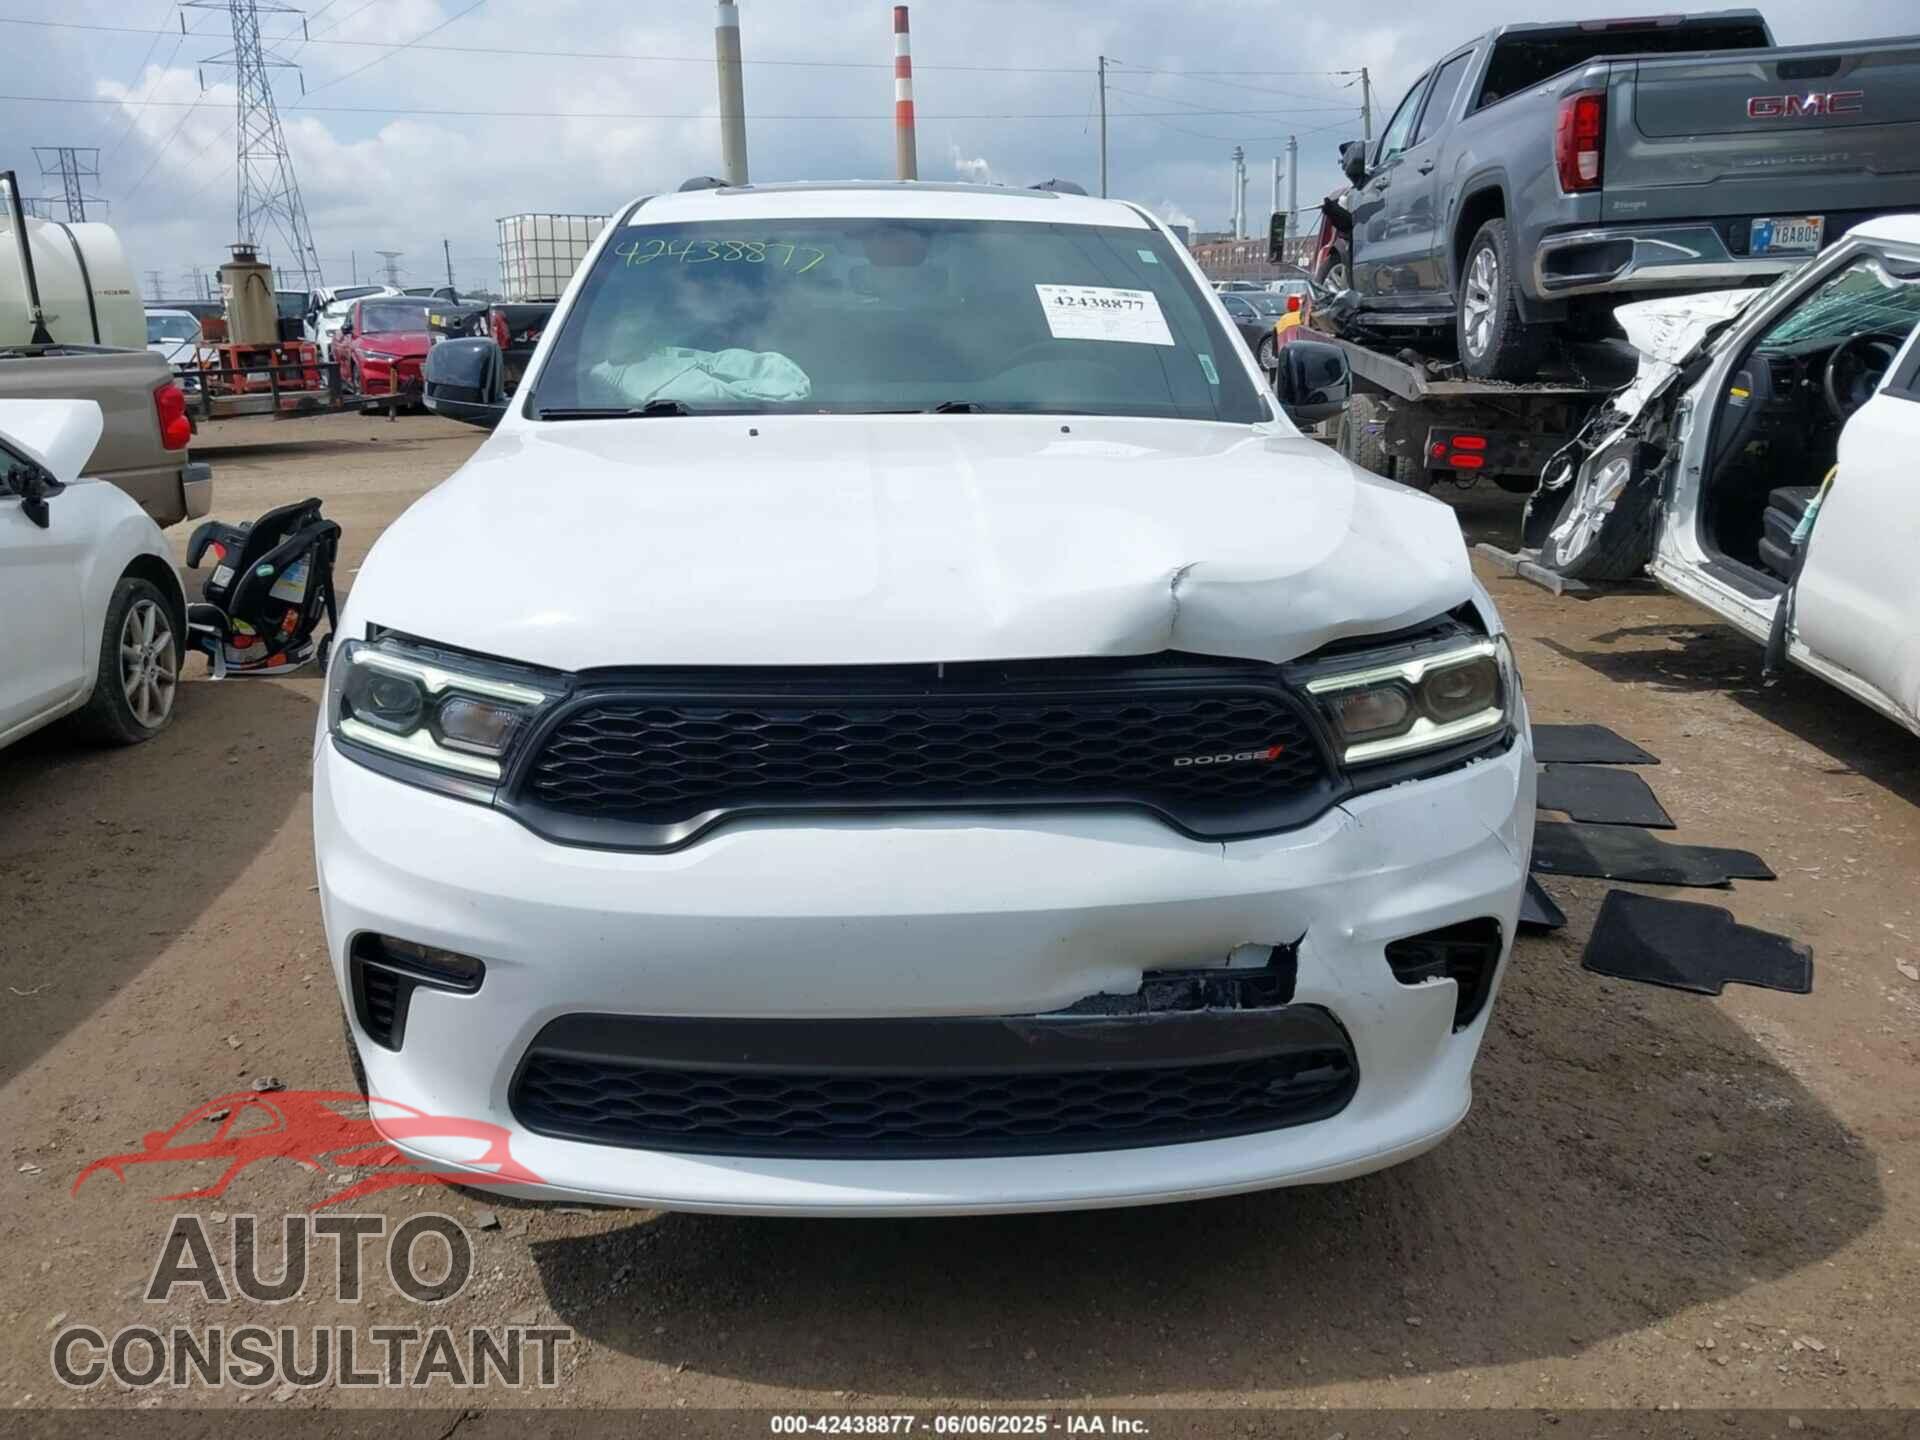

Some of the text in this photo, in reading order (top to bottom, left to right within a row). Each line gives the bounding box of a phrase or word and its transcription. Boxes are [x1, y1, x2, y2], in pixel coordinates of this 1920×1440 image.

[1747, 90, 1864, 118] GMC
[614, 239, 825, 274] 42438877
[1054, 296, 1144, 311] 42438877
[1174, 750, 1272, 766] DODGE
